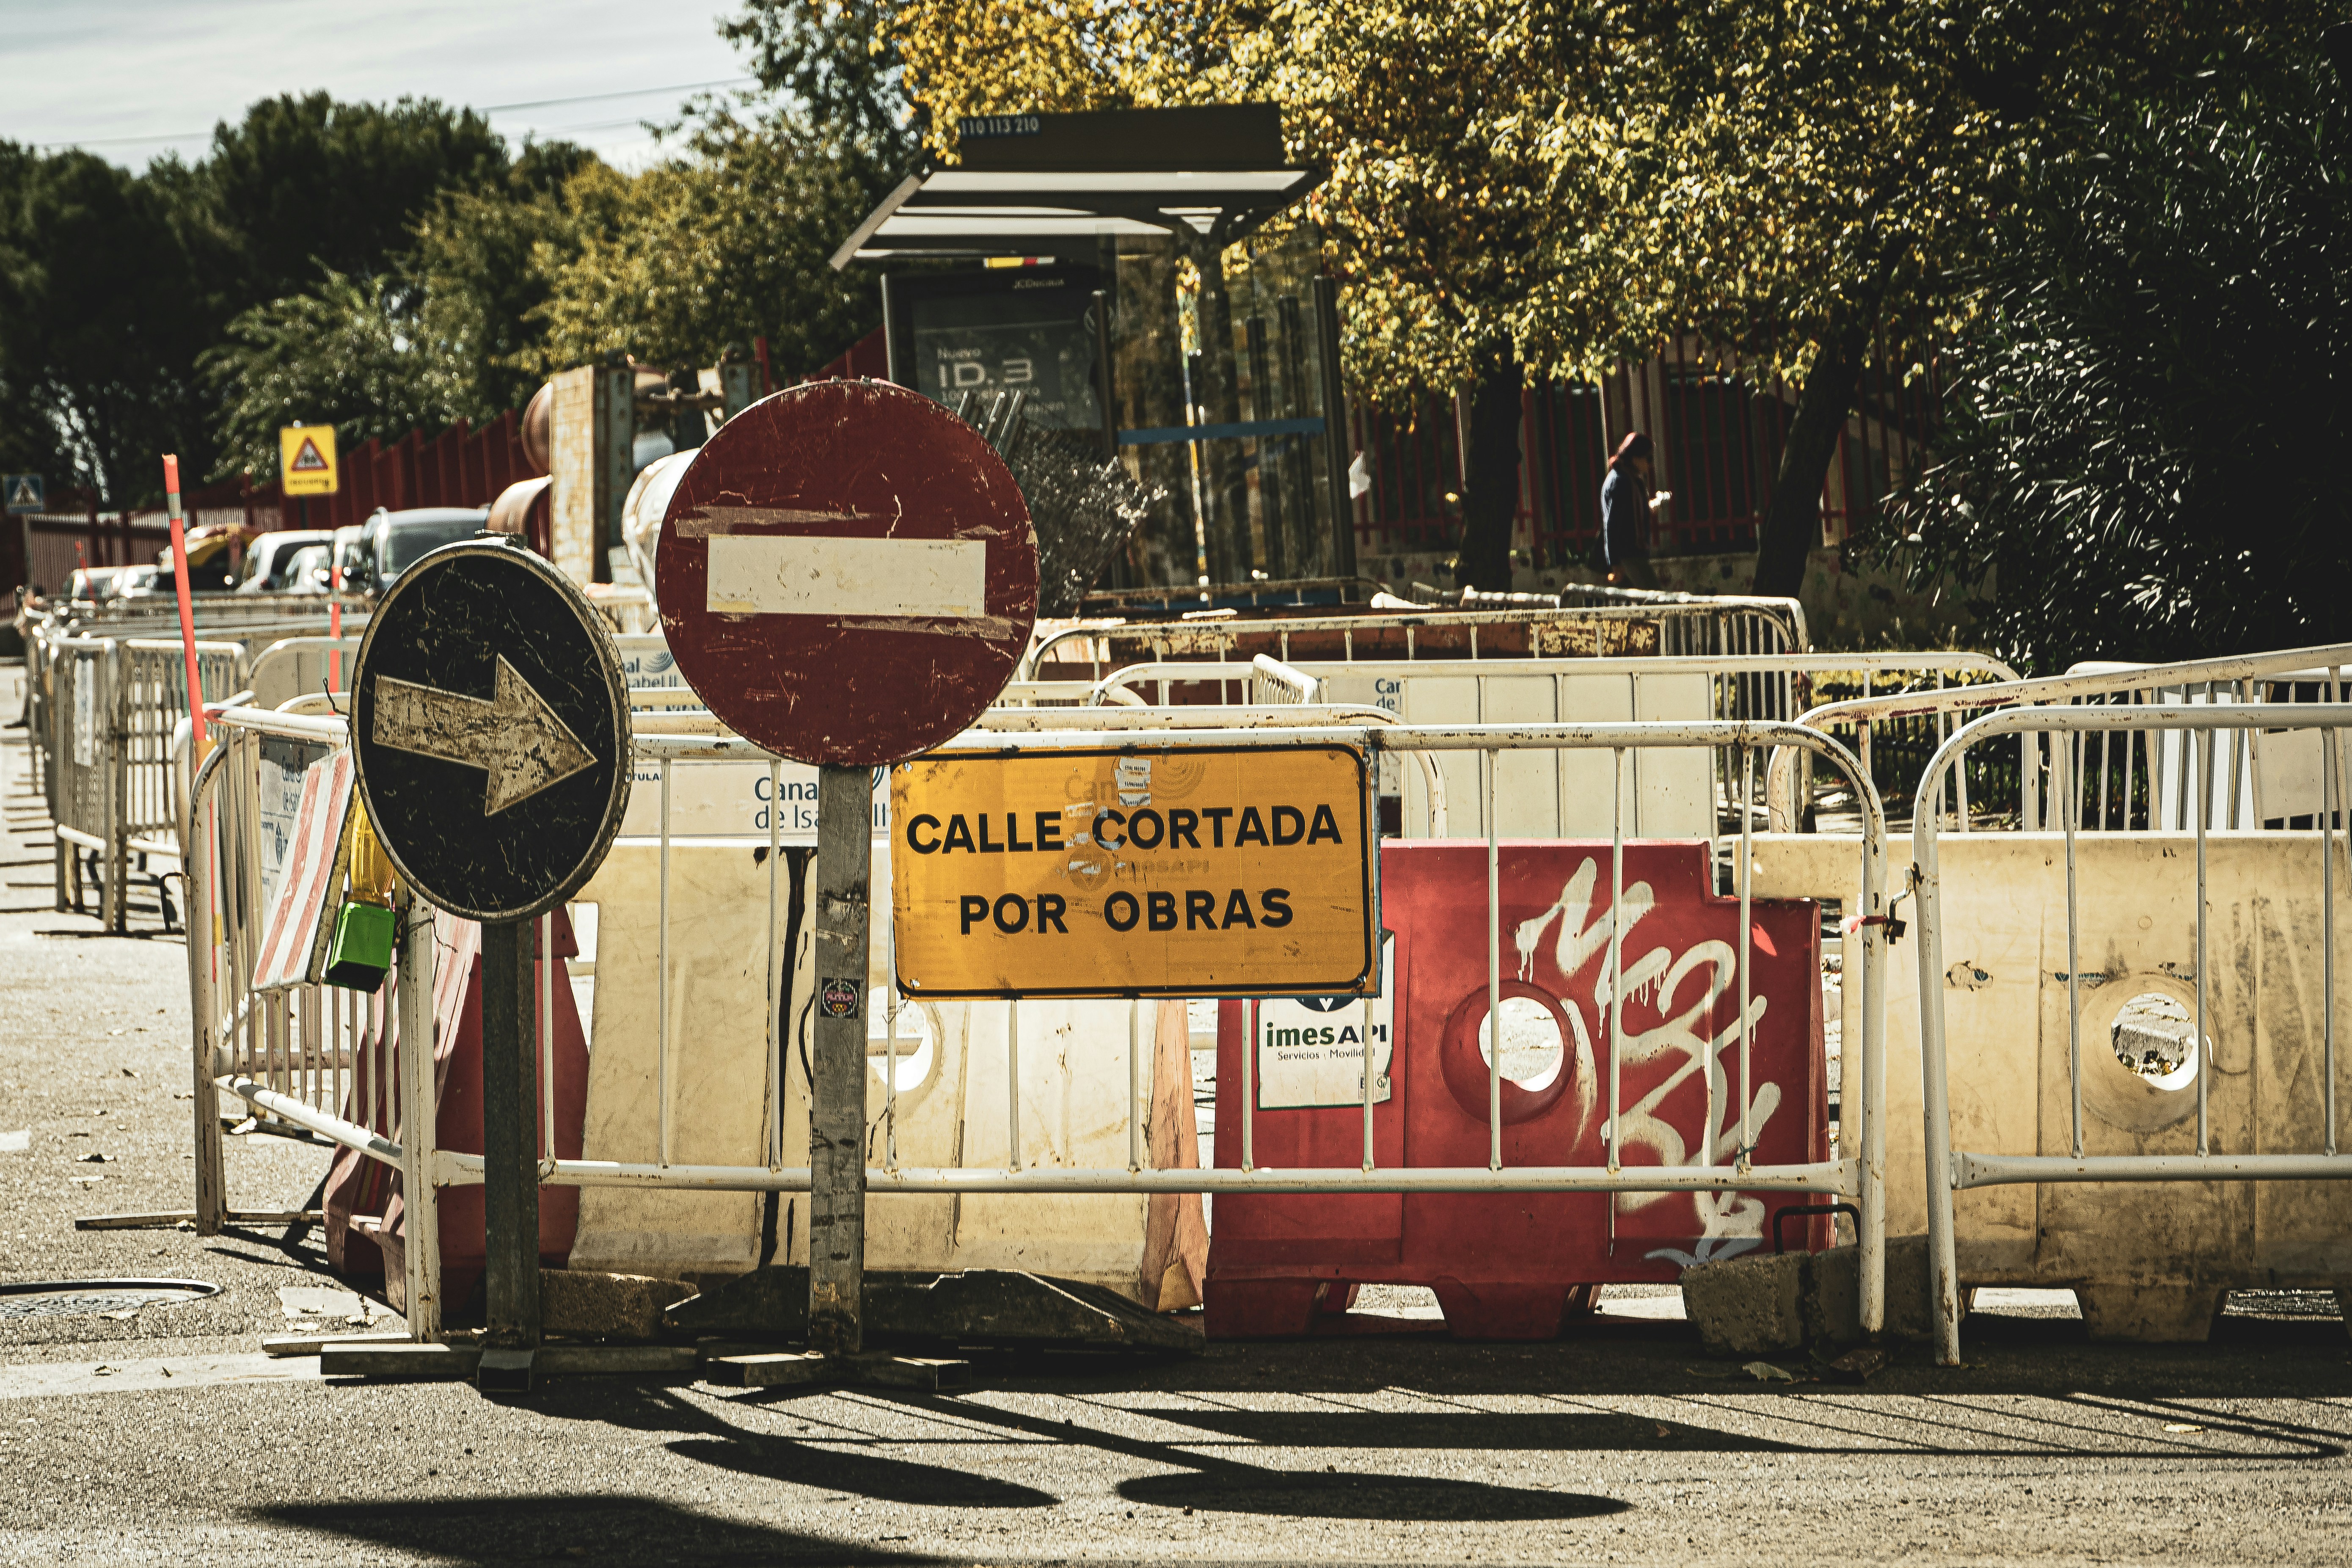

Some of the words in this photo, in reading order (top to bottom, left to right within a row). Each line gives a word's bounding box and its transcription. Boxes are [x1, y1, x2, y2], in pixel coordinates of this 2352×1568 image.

[989, 118, 1011, 135] 113
[1015, 116, 1039, 133] 210
[755, 777, 818, 802] Cana
[906, 811, 1064, 854] CALLE
[1092, 804, 1343, 851] CORTADA
[960, 893, 1069, 935] POR
[1104, 887, 1293, 932] OBRAS
[1278, 1050, 1319, 1061] Servicios
[1330, 1047, 1375, 1059] Movilid
